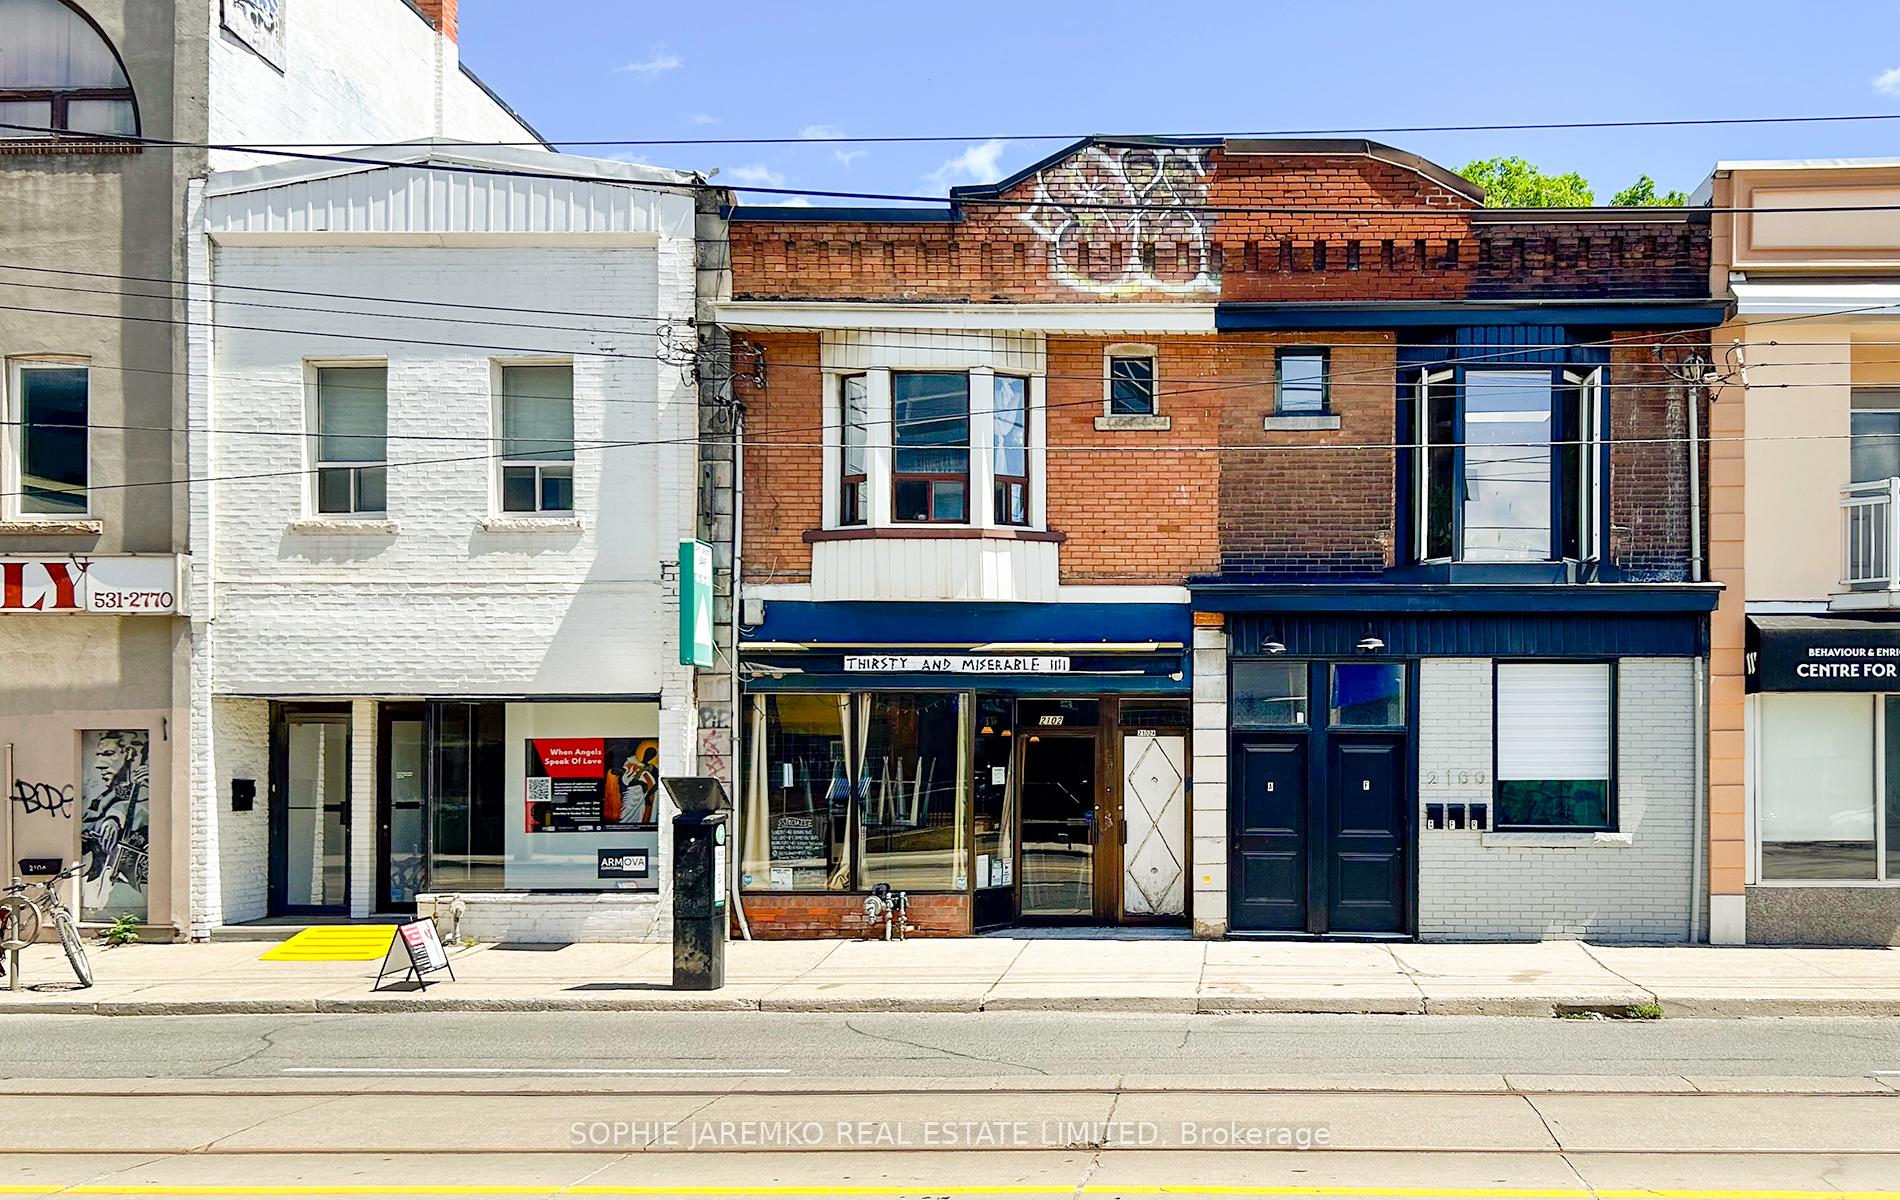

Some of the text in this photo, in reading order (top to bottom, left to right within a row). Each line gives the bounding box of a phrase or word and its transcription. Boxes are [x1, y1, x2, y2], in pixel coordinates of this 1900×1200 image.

[0, 562, 94, 611] LY
[94, 591, 173, 608] 531-2770
[1808, 647, 1900, 657] BEHAVIOUR & ENRI
[846, 658, 908, 670] THIRSTY
[922, 659, 951, 671] AND
[962, 658, 1040, 671] MISERABLE
[1796, 663, 1897, 678] CENTRE FOR
[1040, 716, 1063, 725] 2102
[550, 747, 602, 757] When Angels
[544, 757, 602, 767] Speak Of Love
[601, 857, 645, 866] ARMOVA
